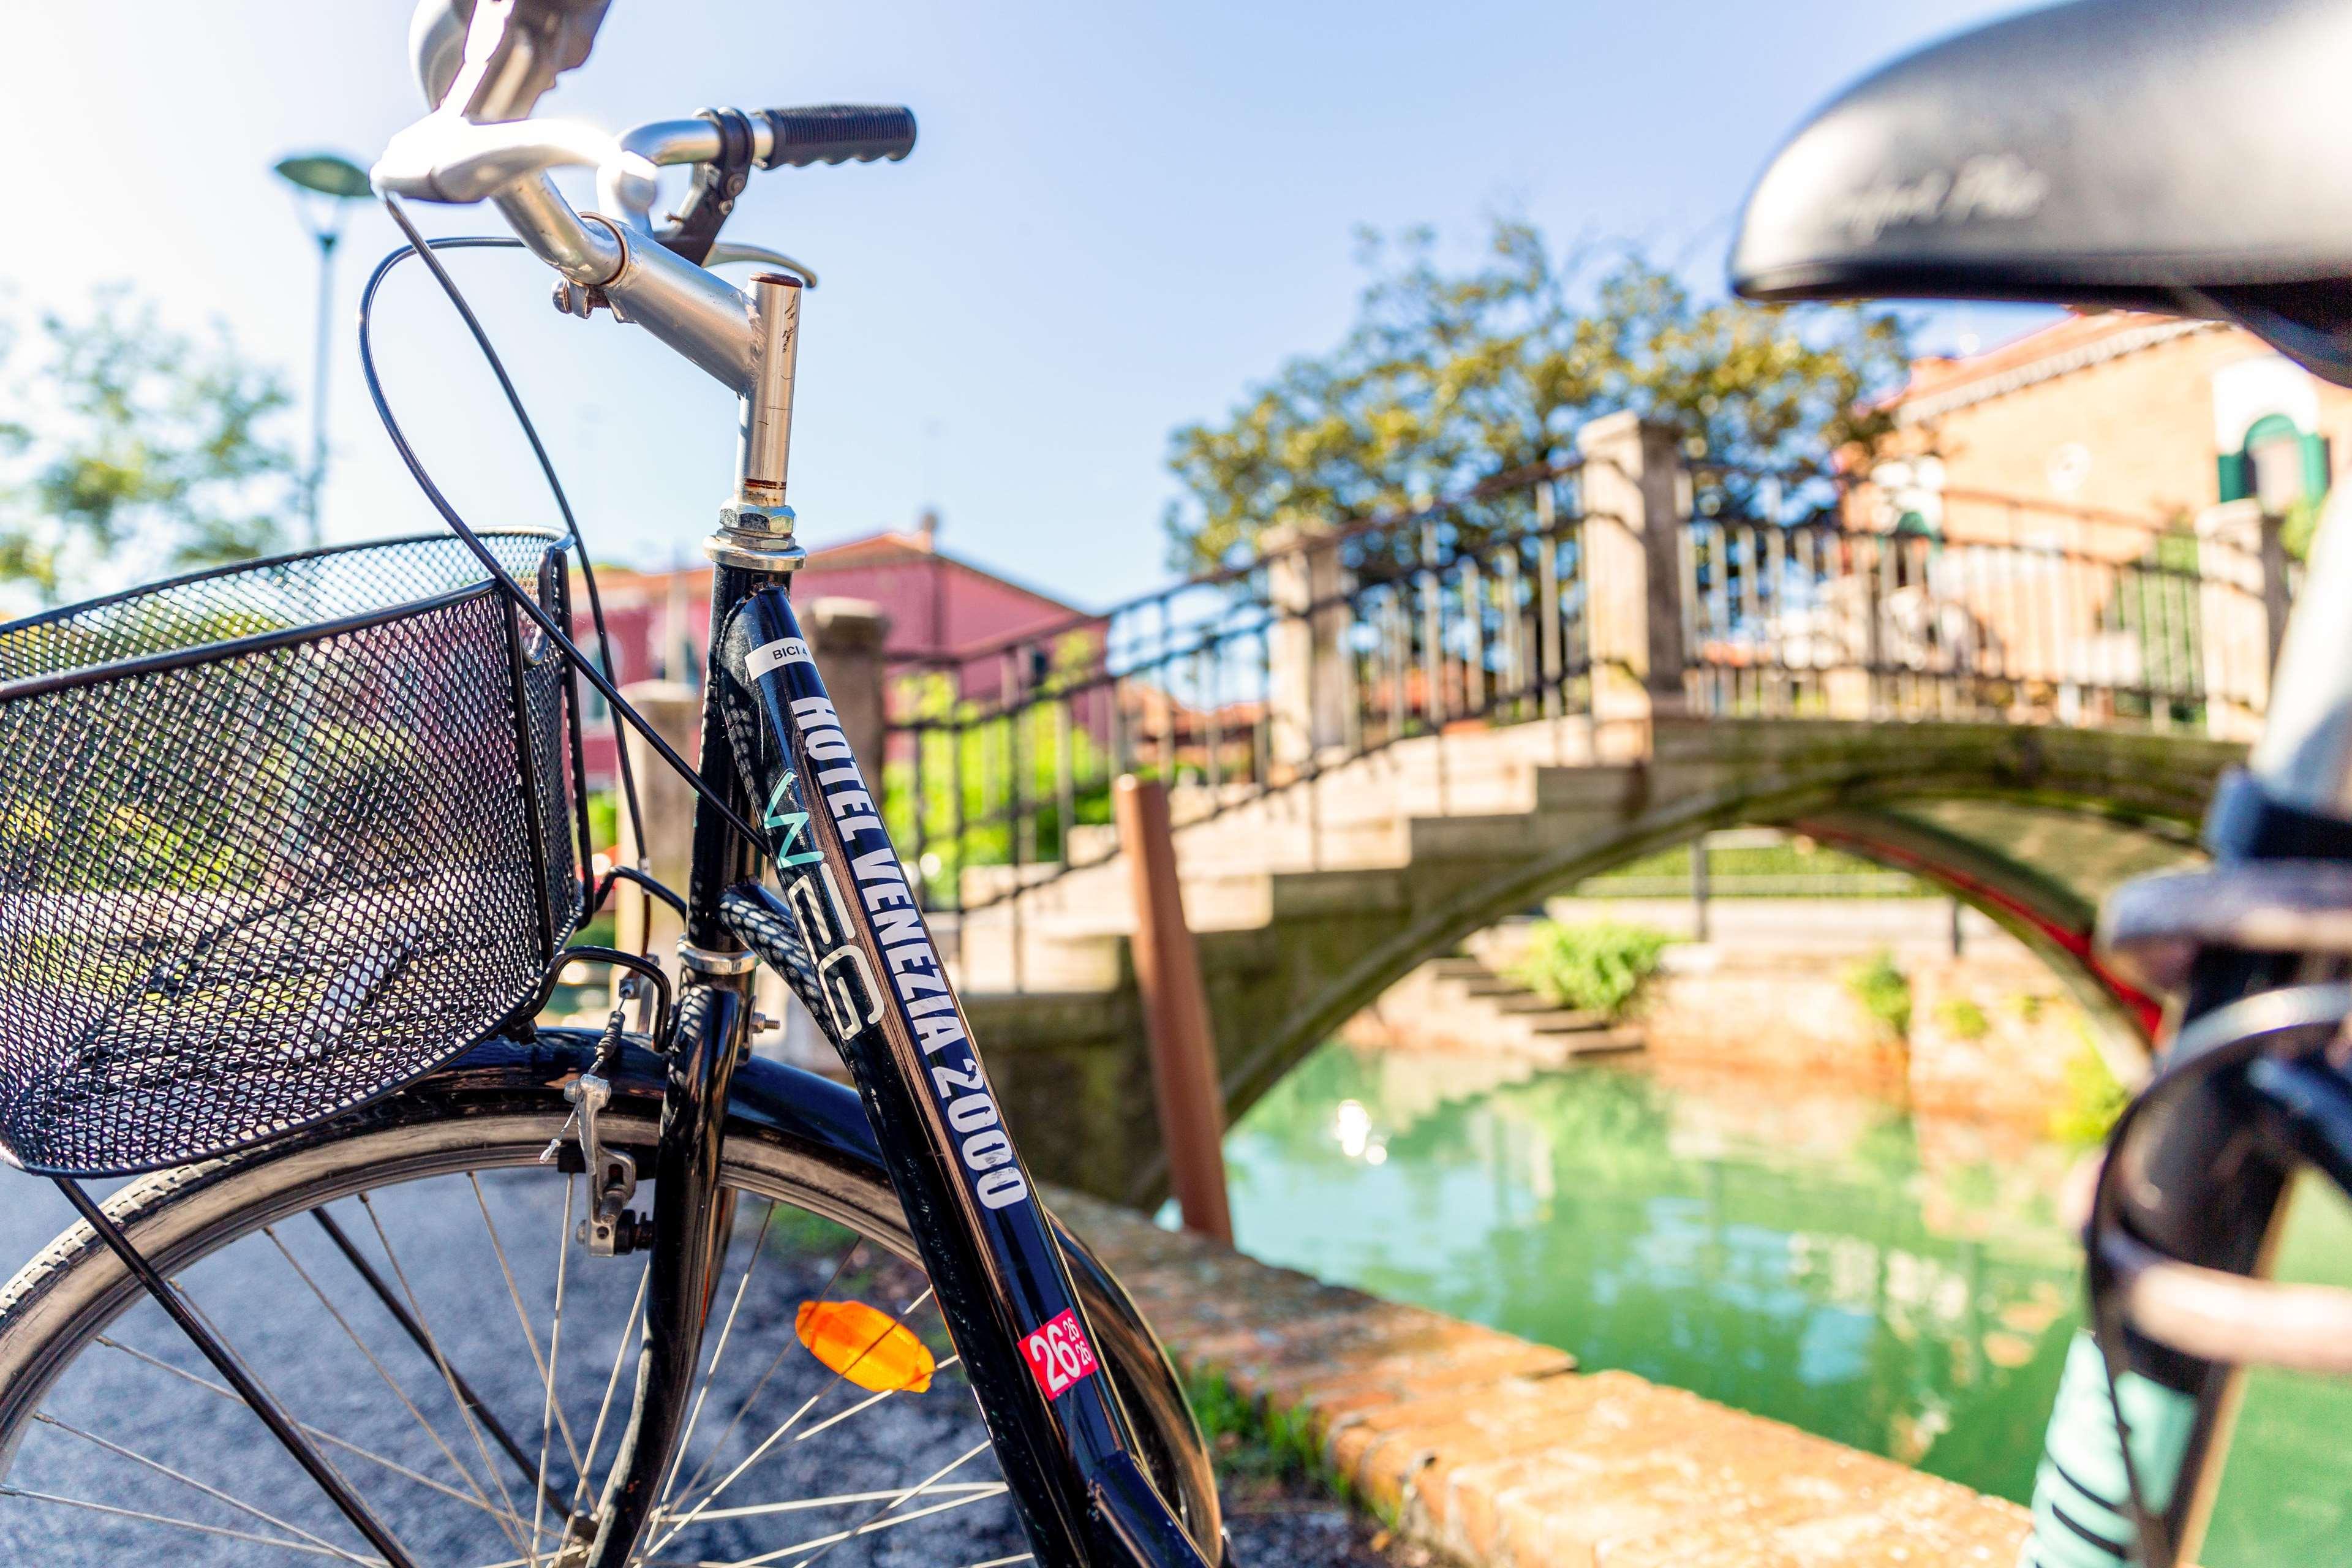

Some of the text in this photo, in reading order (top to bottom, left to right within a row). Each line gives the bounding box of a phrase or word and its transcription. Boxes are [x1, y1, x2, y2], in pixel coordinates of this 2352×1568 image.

[772, 646, 800, 660] BICI
[764, 770, 884, 1039] WEG
[791, 696, 1028, 1209] HOTEL VENEZIA 2000
[1063, 1317, 1080, 1342] 26
[1030, 1324, 1081, 1392] 26
[1075, 1341, 1092, 1366] 26
